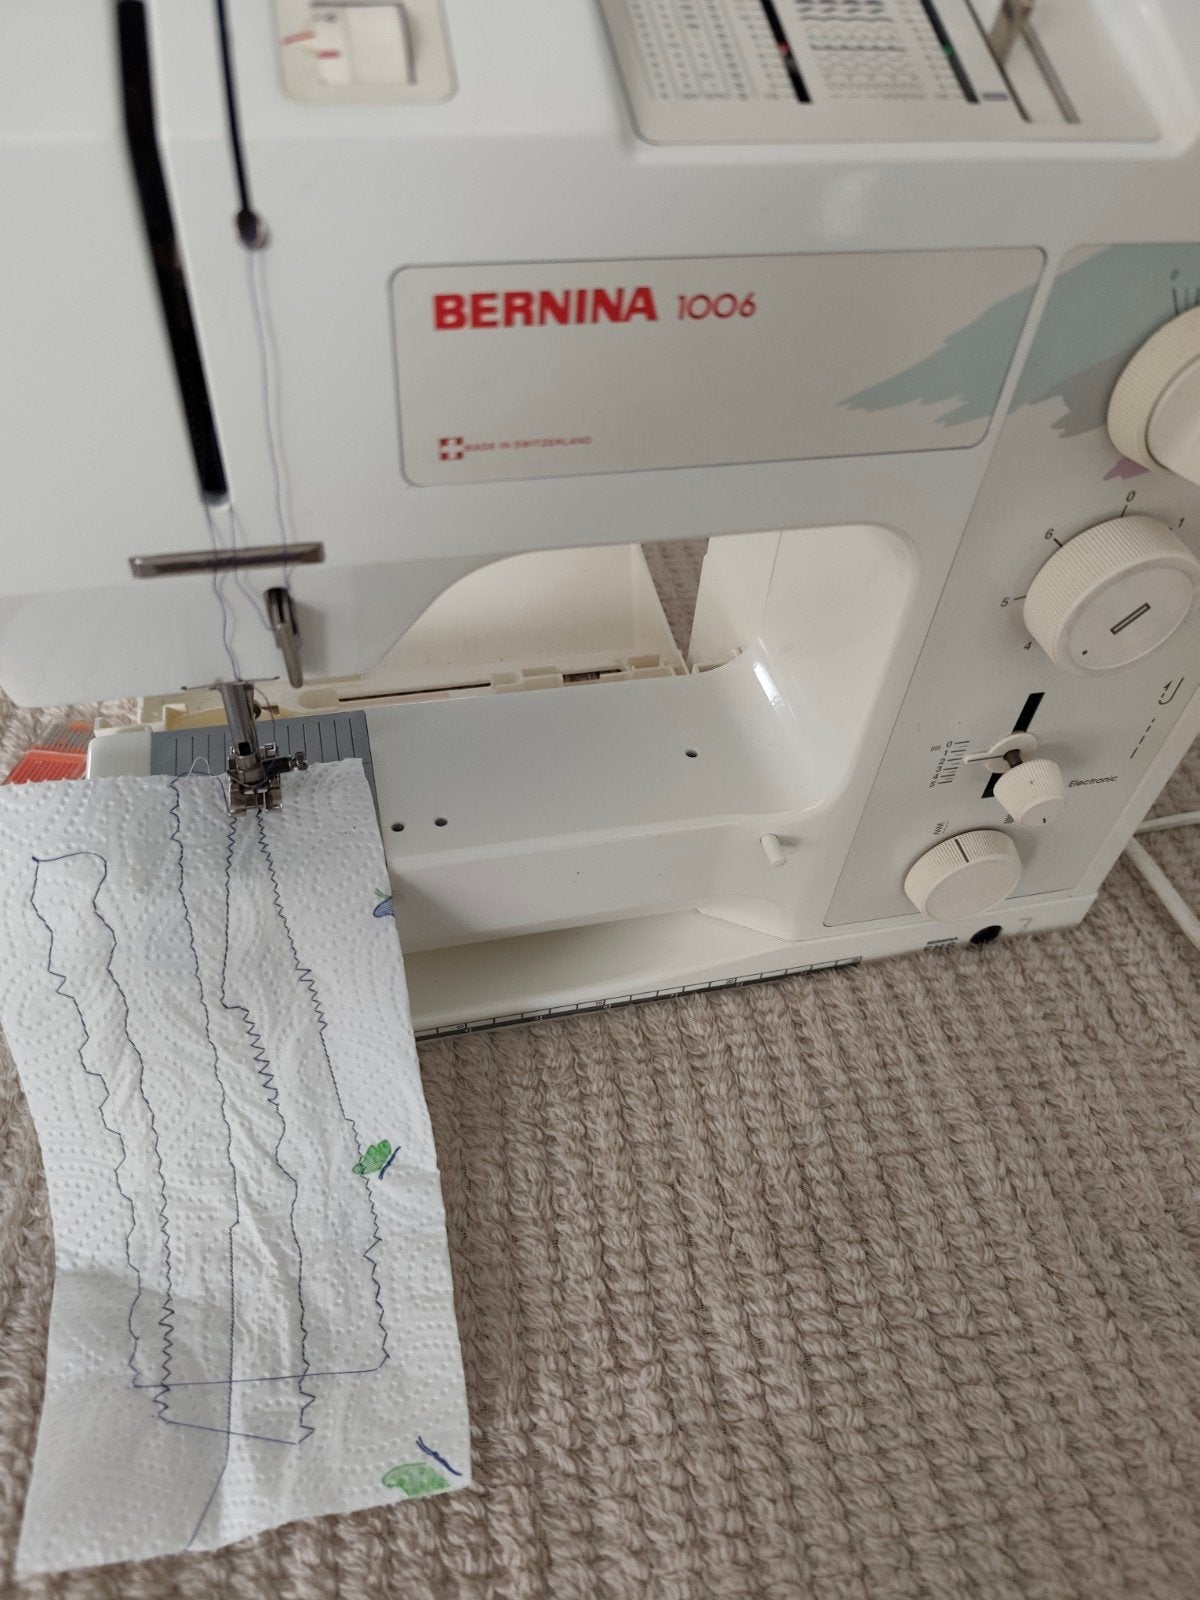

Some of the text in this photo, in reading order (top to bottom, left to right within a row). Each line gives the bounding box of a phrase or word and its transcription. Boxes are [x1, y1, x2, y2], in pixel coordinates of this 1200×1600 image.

[433, 286, 757, 330] BERNINA 1006
[1125, 490, 1136, 502] 0
[1177, 516, 1186, 528] 1
[1044, 528, 1054, 540] 6
[1000, 597, 1010, 608] 5
[1023, 640, 1033, 651] 4
[946, 740, 953, 748] 0
[1068, 775, 1118, 788] Electronic
